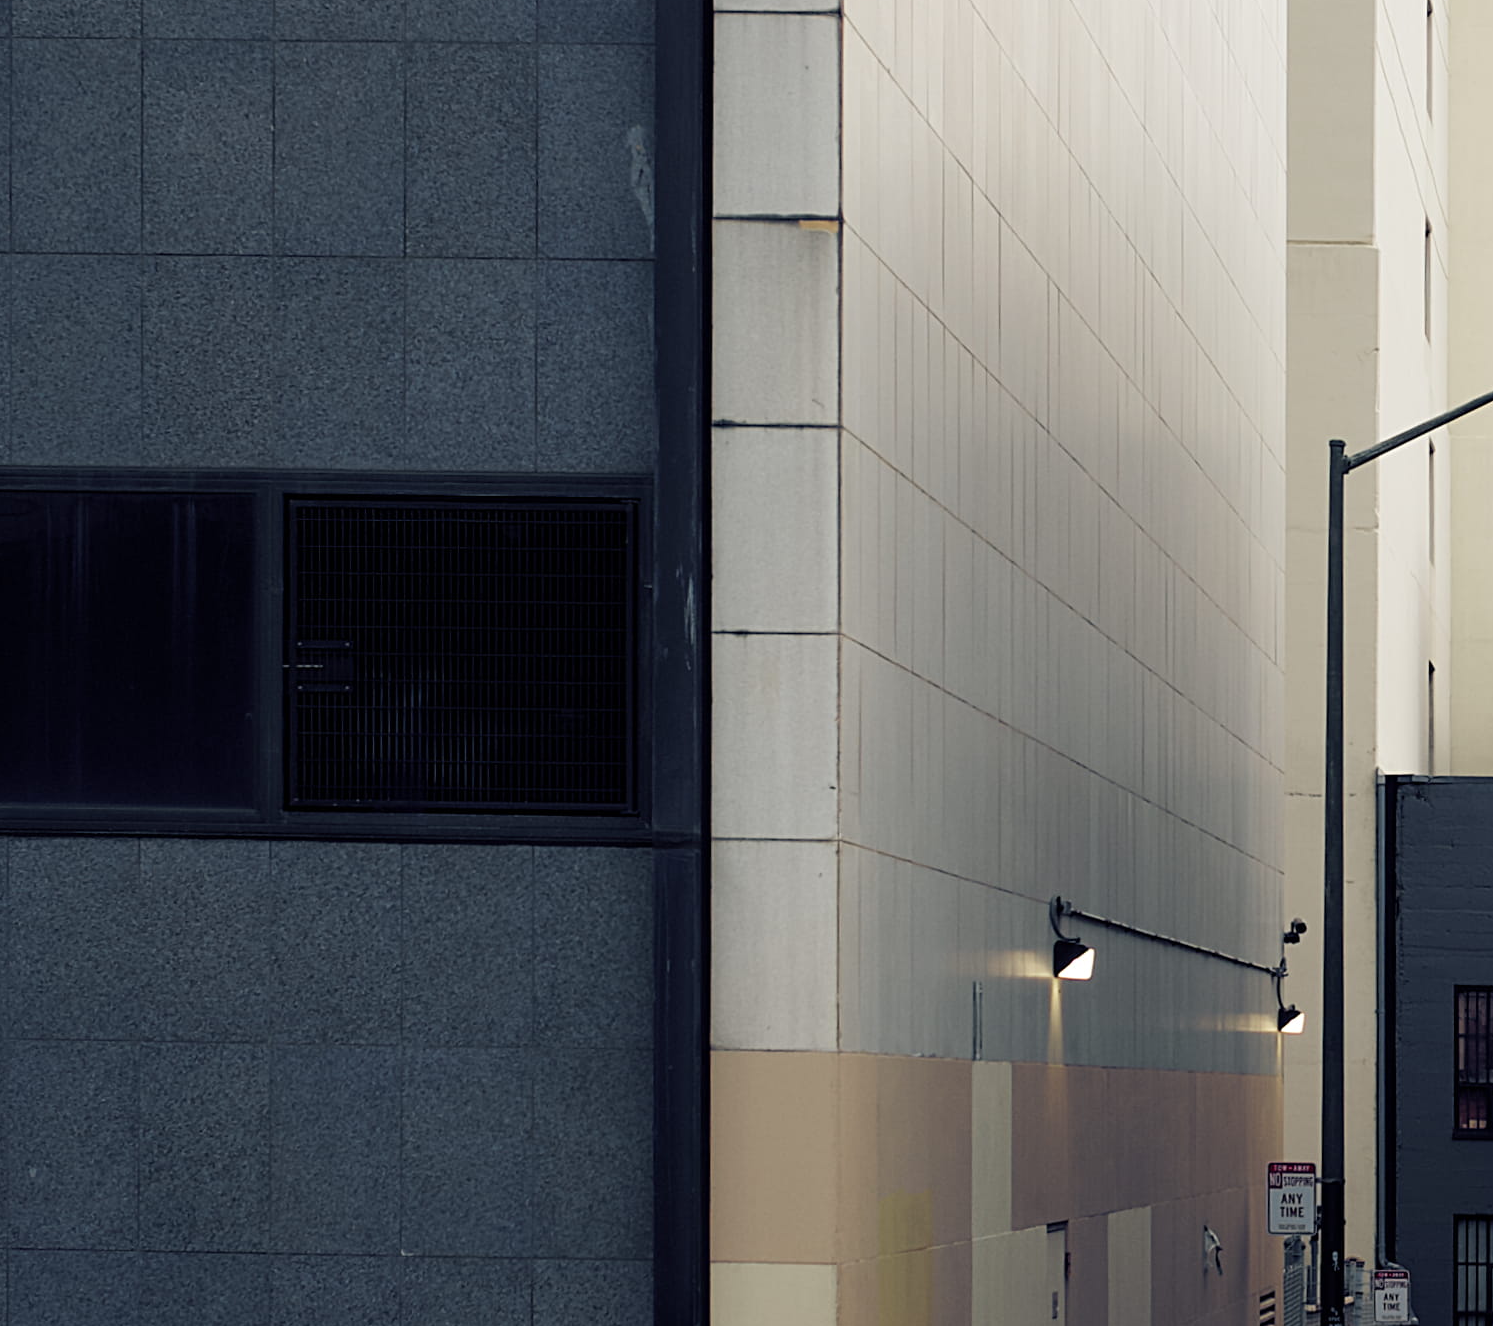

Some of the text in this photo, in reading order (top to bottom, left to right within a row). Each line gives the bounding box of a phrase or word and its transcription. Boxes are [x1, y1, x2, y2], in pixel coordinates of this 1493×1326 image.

[1269, 1173, 1314, 1187] NO STOPPING
[1281, 1193, 1303, 1205] ANY
[1280, 1207, 1305, 1218] TIME
[1383, 1292, 1400, 1302] ANY
[1383, 1302, 1401, 1311] TIME
